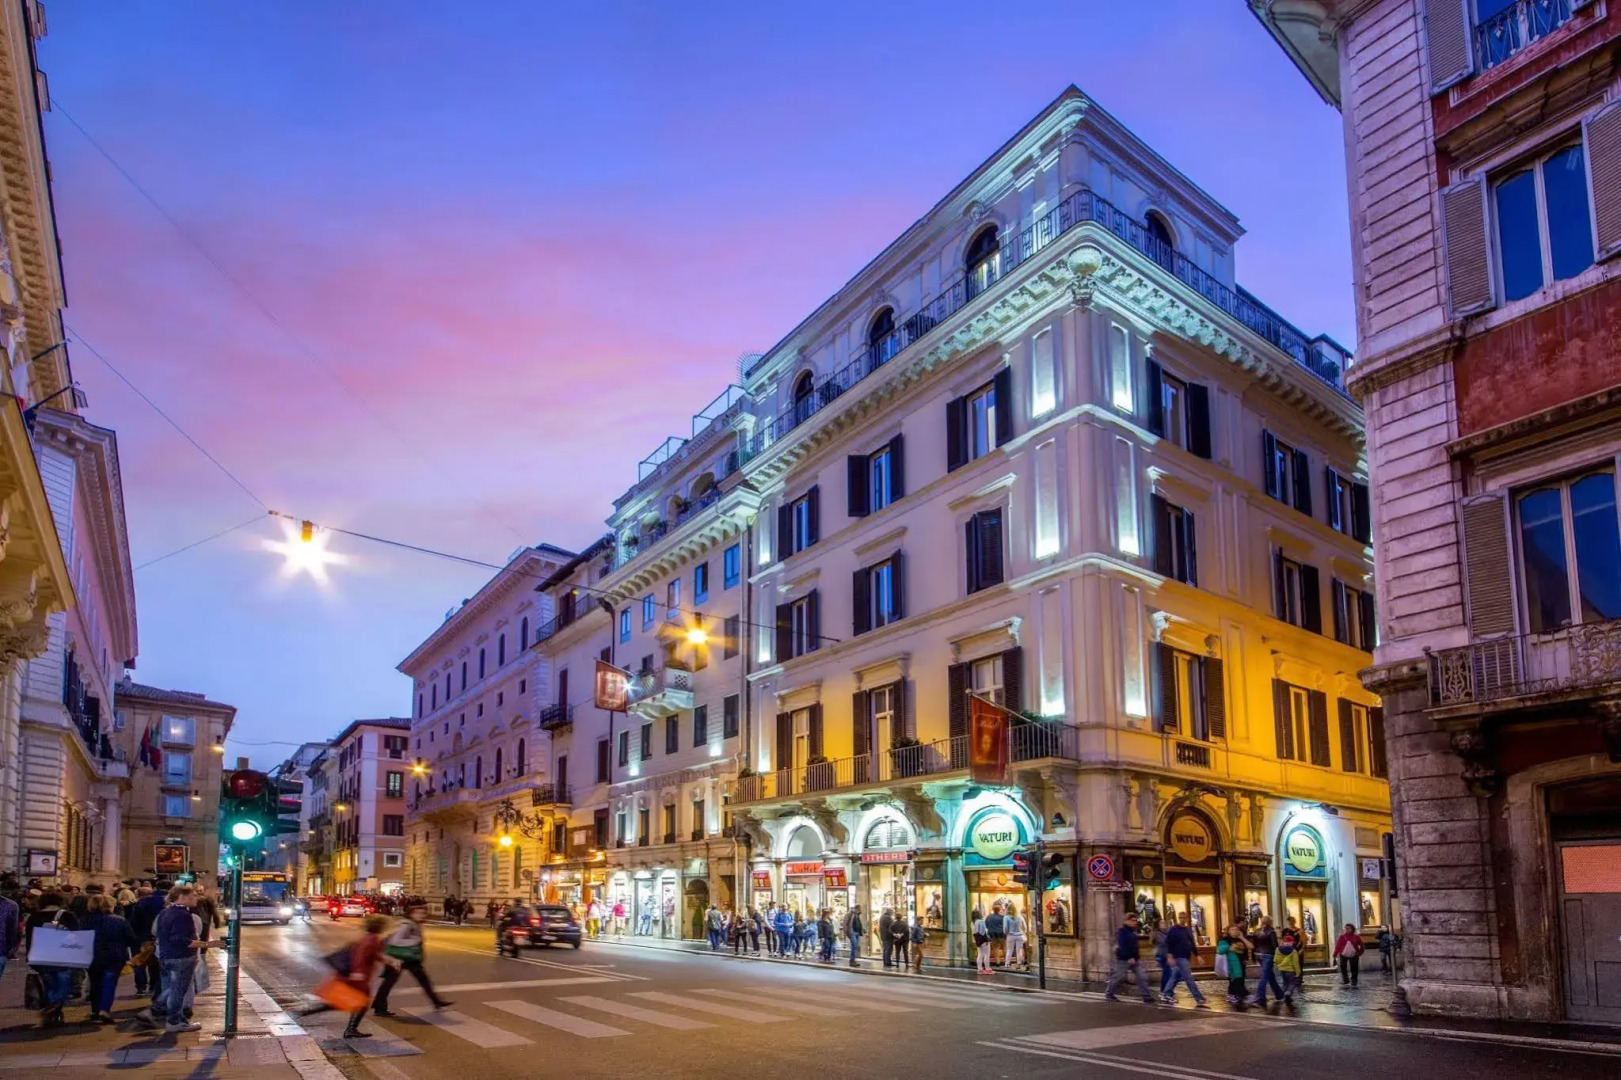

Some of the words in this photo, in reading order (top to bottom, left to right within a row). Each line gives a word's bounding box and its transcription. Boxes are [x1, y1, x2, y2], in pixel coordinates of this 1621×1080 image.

[979, 832, 1012, 843] VATURI
[1175, 834, 1204, 846] VATURI
[1291, 847, 1315, 857] VATURI
